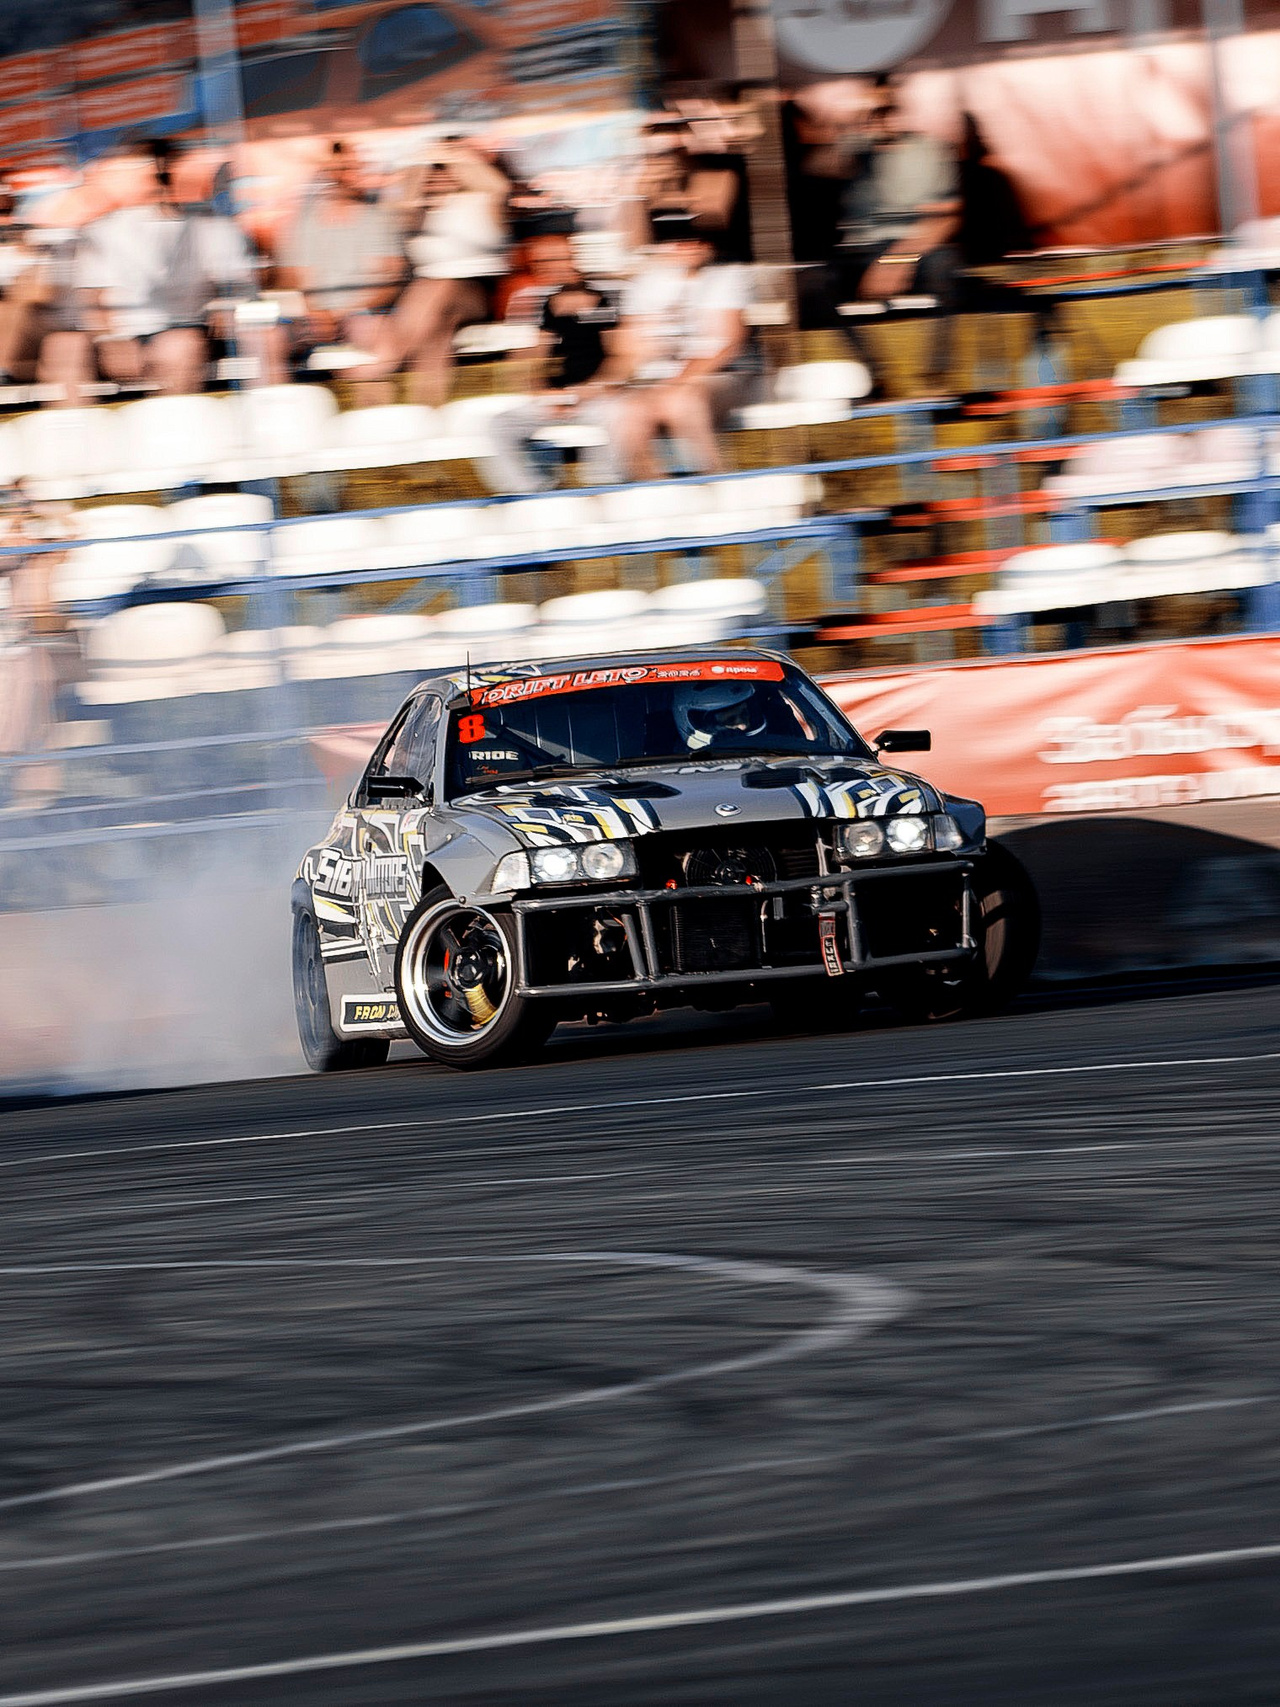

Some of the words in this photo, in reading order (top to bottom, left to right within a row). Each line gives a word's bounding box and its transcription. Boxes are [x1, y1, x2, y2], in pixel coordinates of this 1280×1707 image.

[481, 674, 570, 704] DRIFT
[572, 667, 647, 686] LETO
[458, 714, 485, 743] 8
